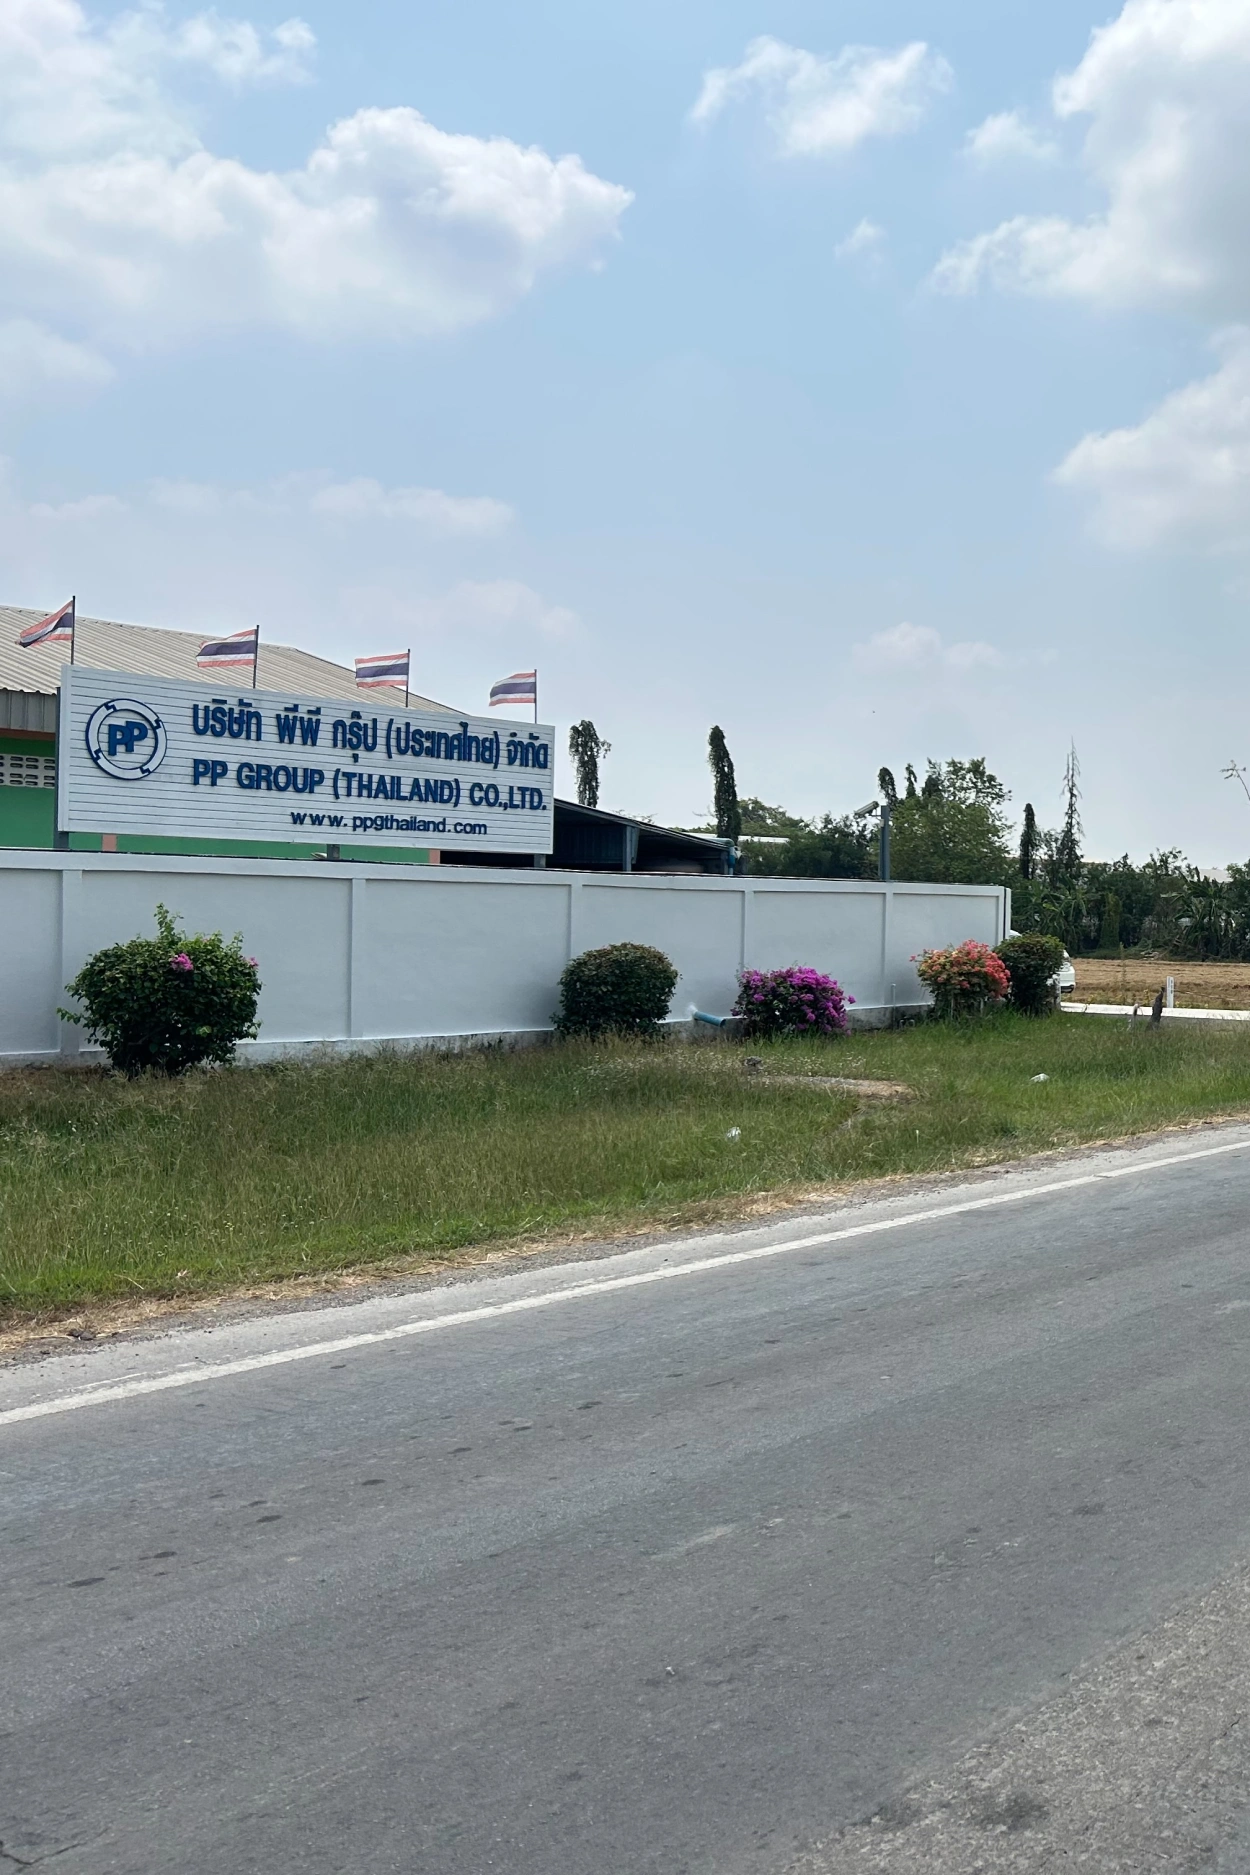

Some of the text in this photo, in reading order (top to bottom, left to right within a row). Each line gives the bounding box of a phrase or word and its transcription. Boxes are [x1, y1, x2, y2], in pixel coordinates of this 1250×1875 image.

[108, 720, 149, 756] PP
[193, 698, 549, 769] บริษัท พีพี กรุ๊ป (ประเทศไทย) จำกัด
[193, 758, 548, 811] PP GROUP (THAILAND) CO.,LTD.
